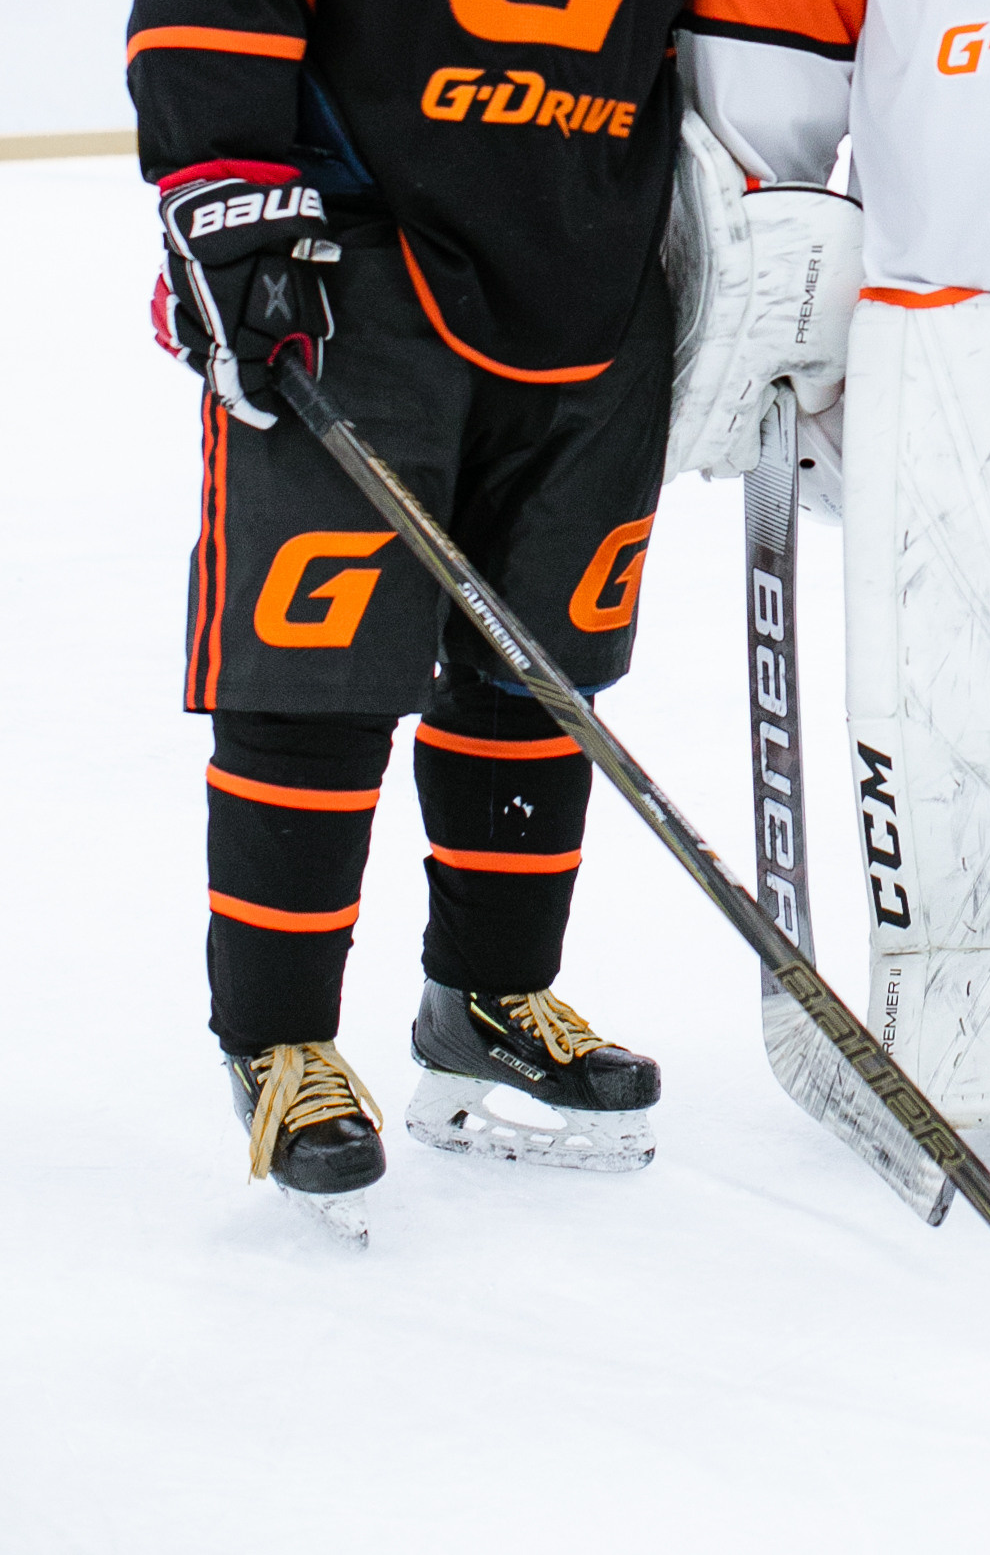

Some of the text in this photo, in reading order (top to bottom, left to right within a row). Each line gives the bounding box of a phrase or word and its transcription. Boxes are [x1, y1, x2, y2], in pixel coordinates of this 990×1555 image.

[189, 186, 327, 239] BAUE
[795, 258, 822, 344] PREMIER
[253, 530, 399, 648] G
[857, 739, 912, 931] CCM
